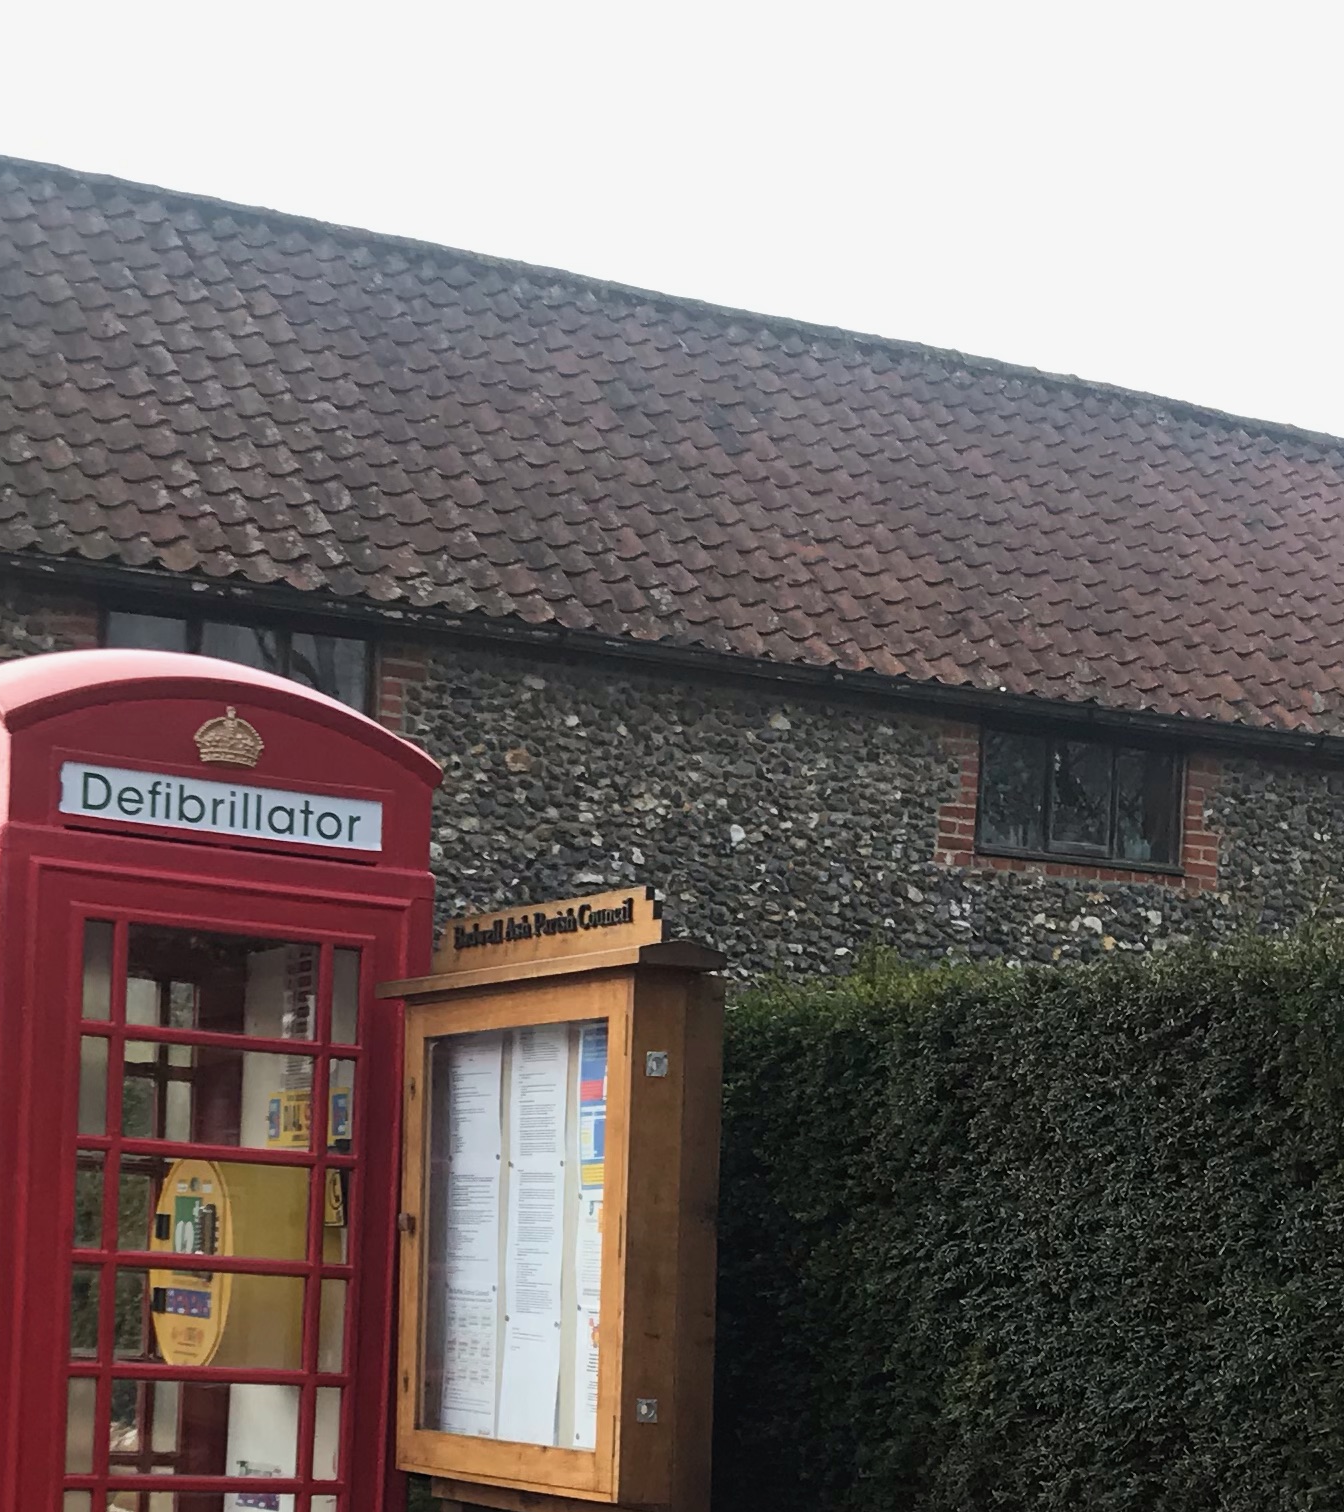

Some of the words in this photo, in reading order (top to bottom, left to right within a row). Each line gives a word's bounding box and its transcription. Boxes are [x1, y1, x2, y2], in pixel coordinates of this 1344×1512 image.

[81, 772, 362, 842] Defibrillator
[533, 907, 578, 937] Parish
[578, 897, 634, 930] Council
